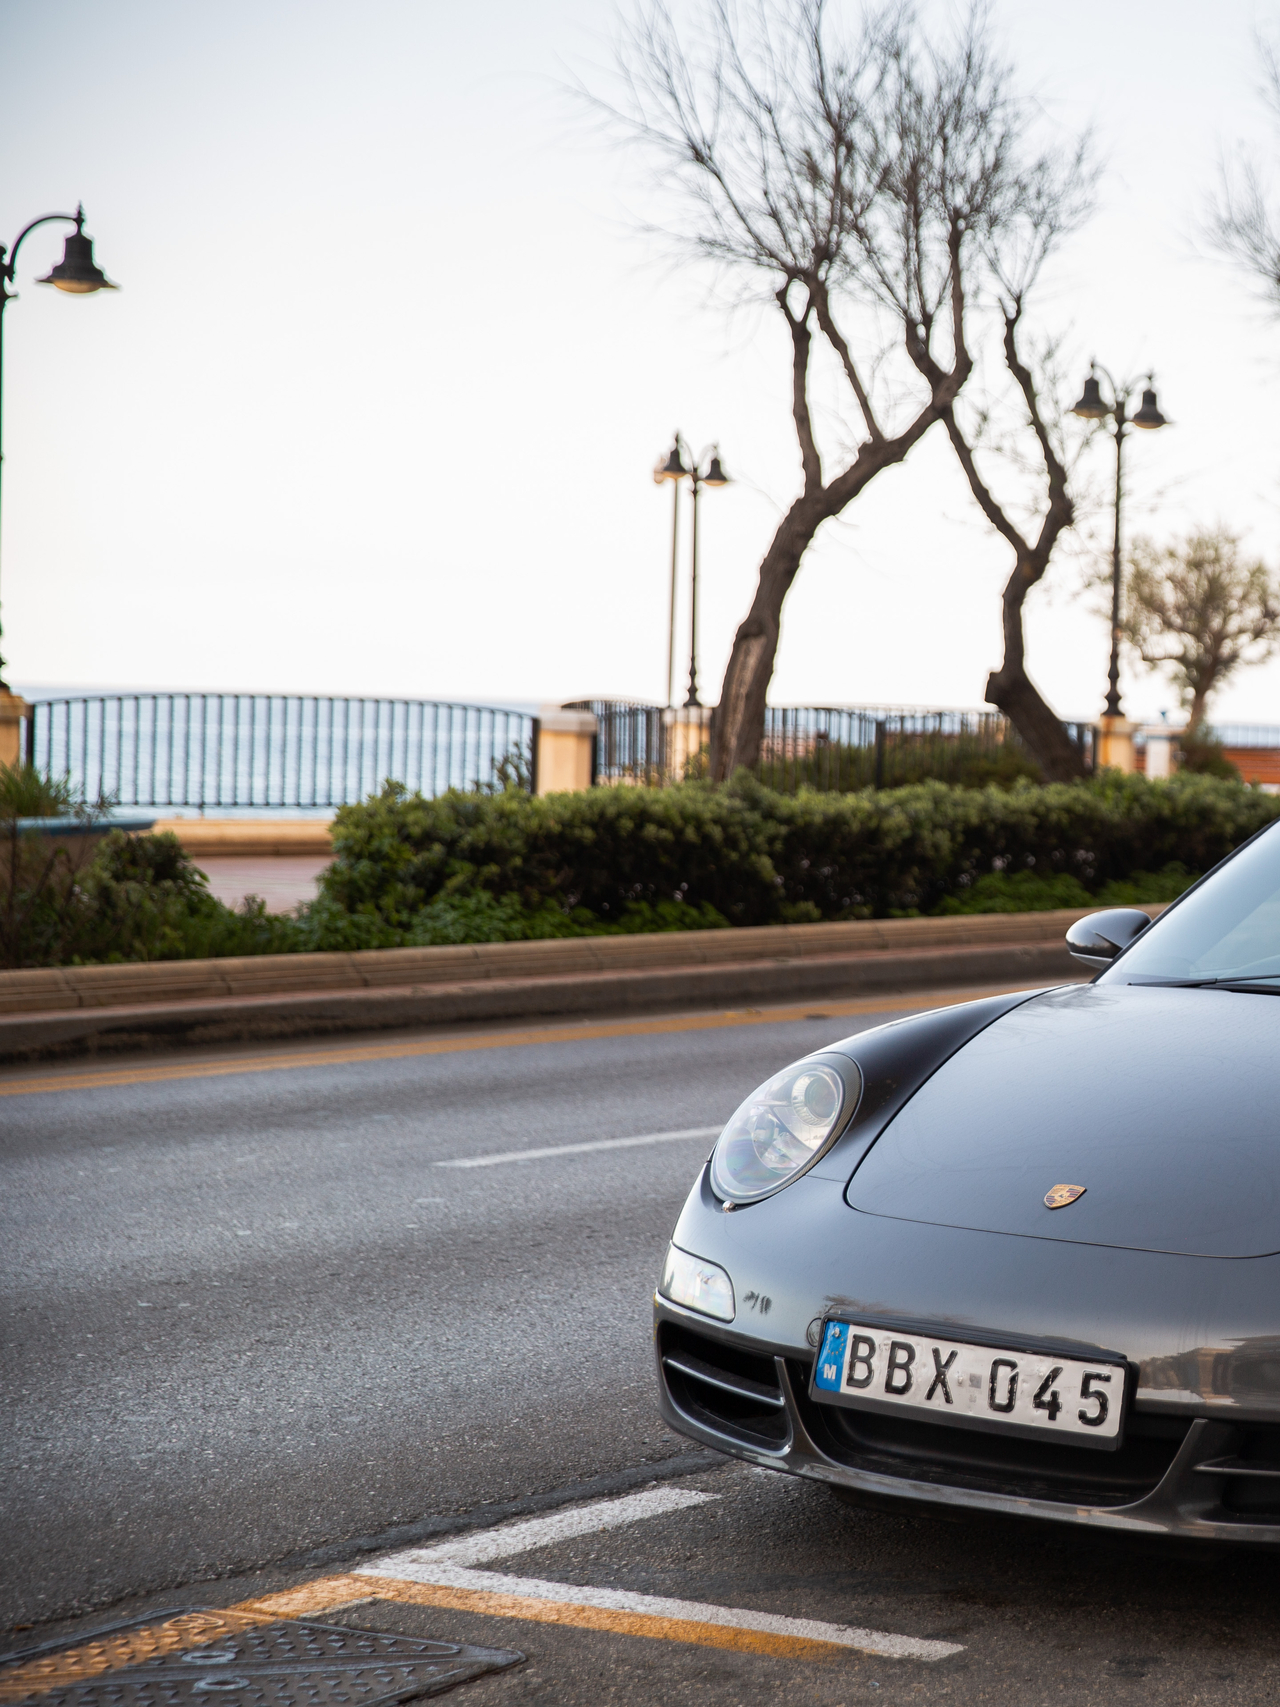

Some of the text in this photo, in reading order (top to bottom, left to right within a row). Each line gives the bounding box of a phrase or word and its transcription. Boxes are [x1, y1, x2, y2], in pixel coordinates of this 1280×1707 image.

[823, 1364, 837, 1380] M
[846, 1333, 1112, 1426] BBX 045
